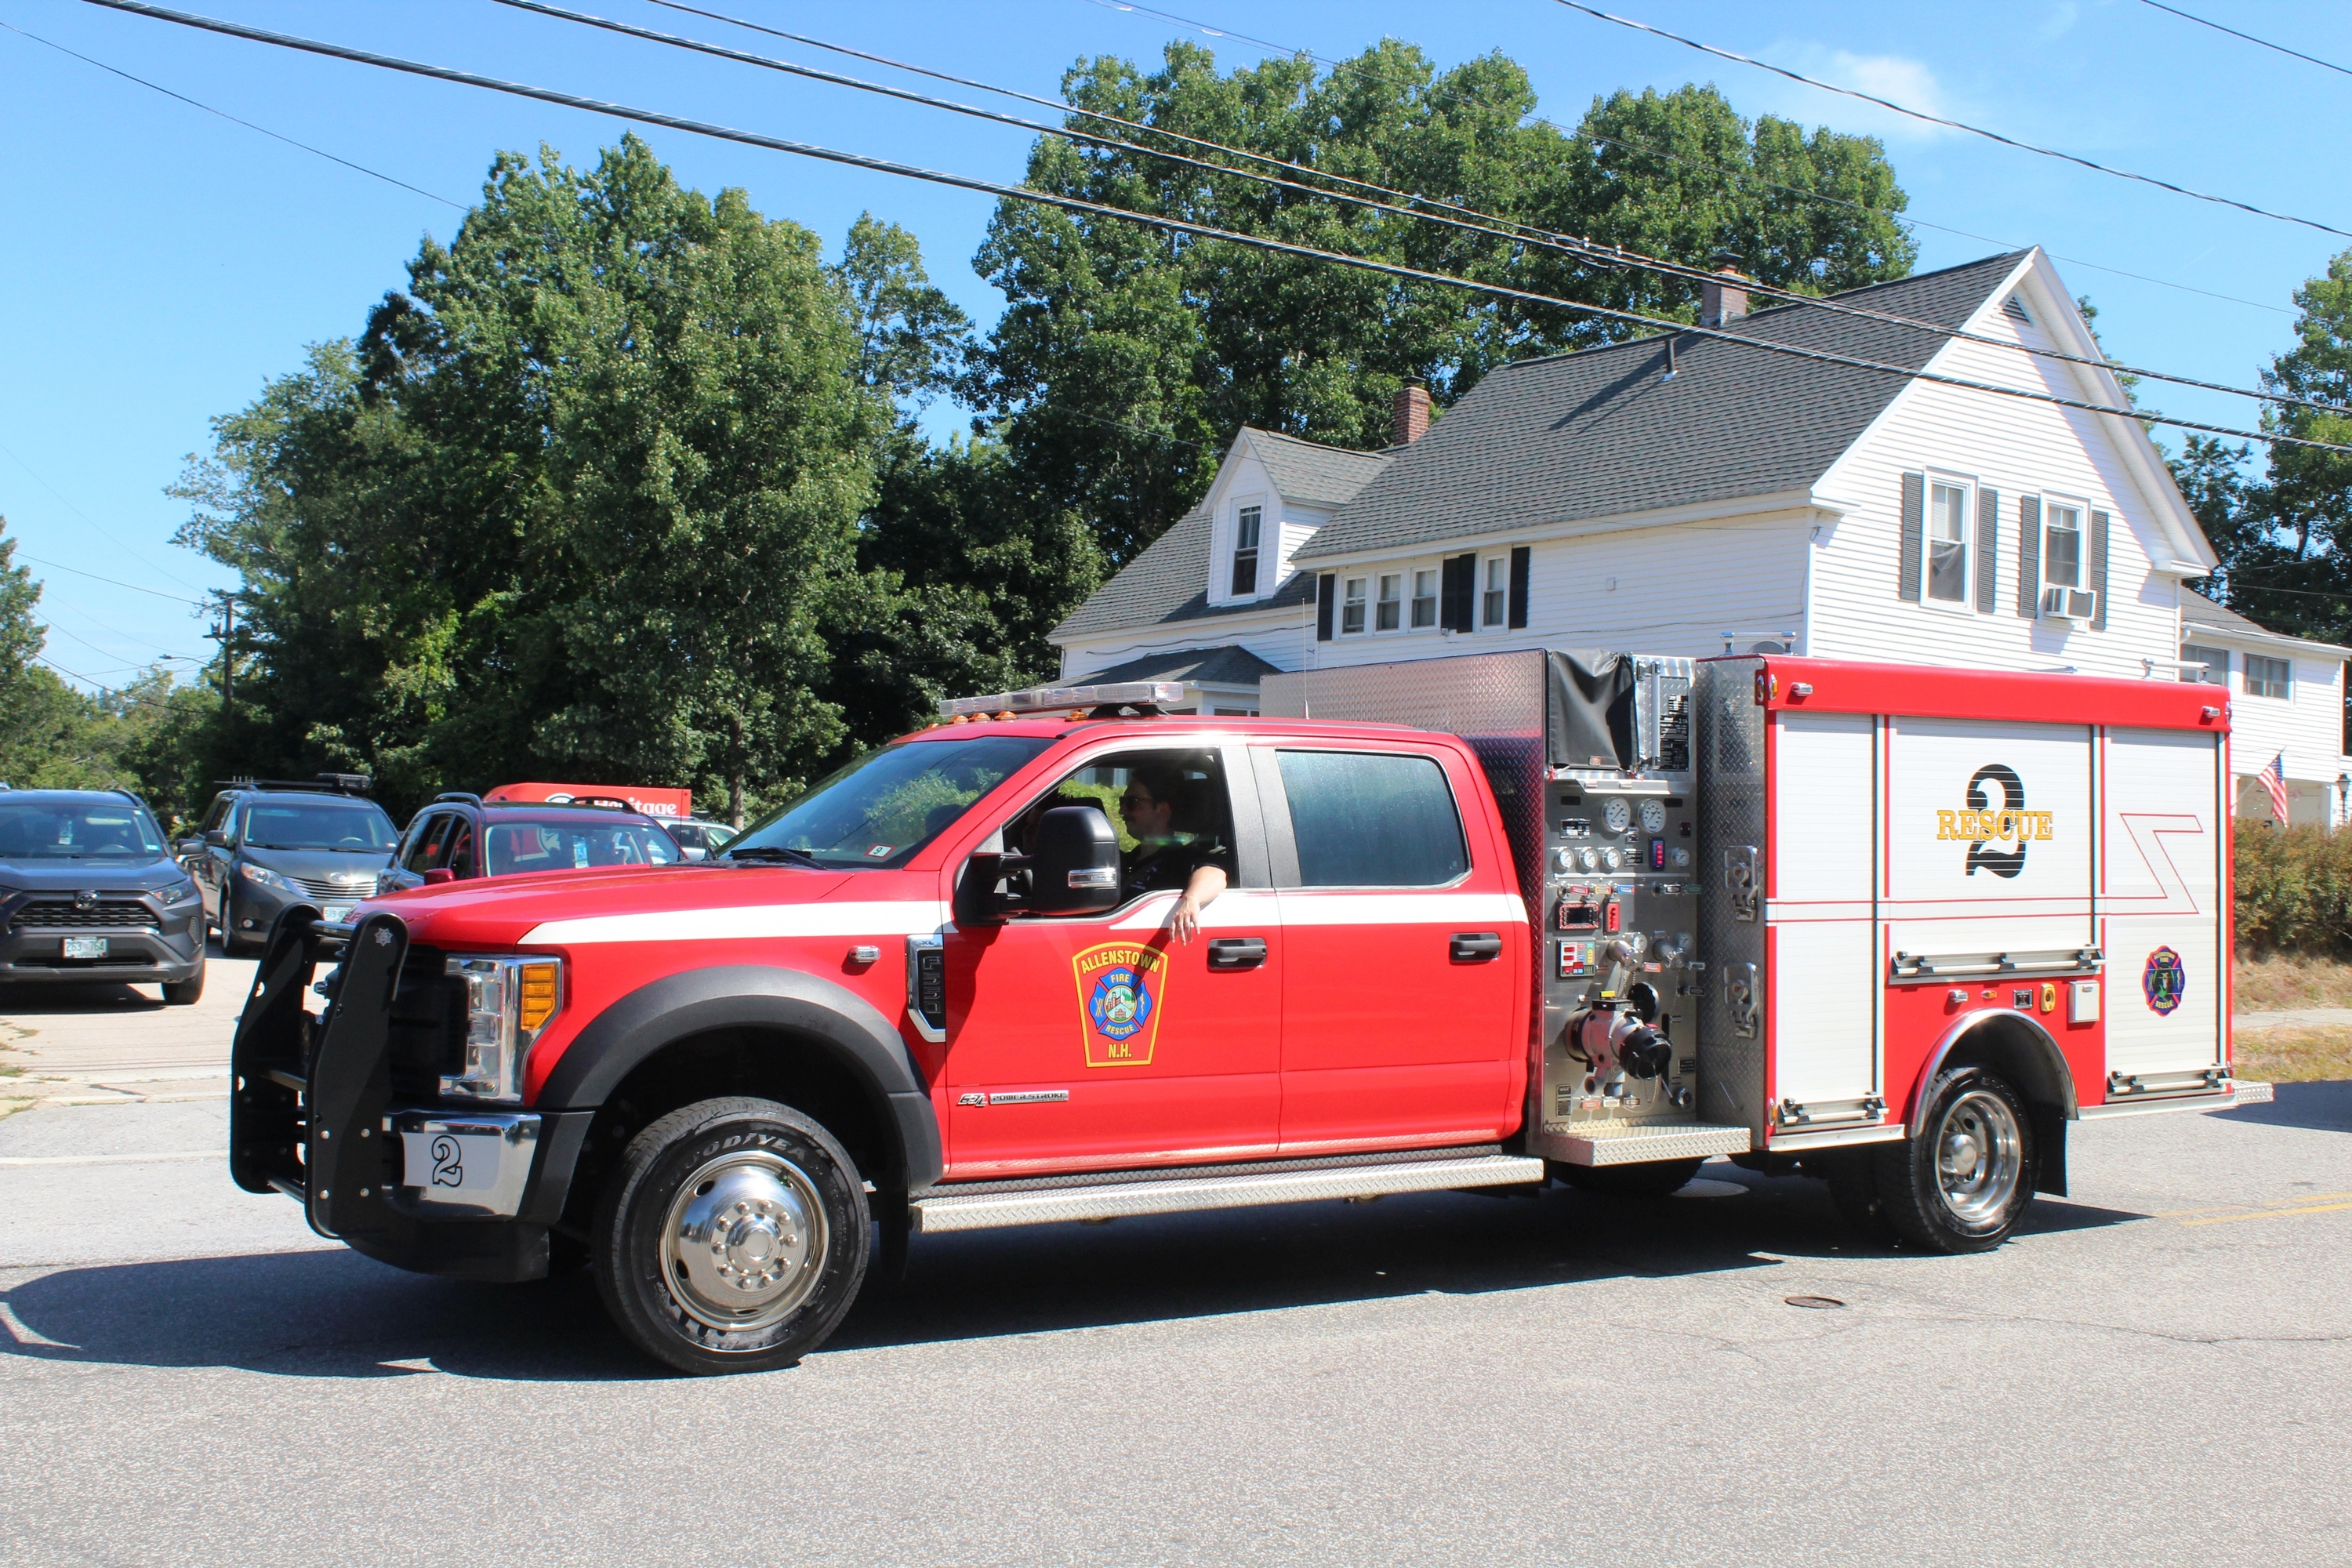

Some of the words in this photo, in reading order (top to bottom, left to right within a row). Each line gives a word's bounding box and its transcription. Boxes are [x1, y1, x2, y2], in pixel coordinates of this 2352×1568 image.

[1936, 810, 2053, 840] RESCUE
[1965, 764, 2026, 878] 2
[66, 942, 82, 952] 263
[89, 941, 104, 951] 764
[1080, 949, 1160, 975] ALLENSTOWN
[1110, 973, 1130, 983] FIRE
[1105, 1024, 1134, 1035] RESCUE
[1108, 1044, 1132, 1058] N.H.
[432, 1135, 463, 1187] 2
